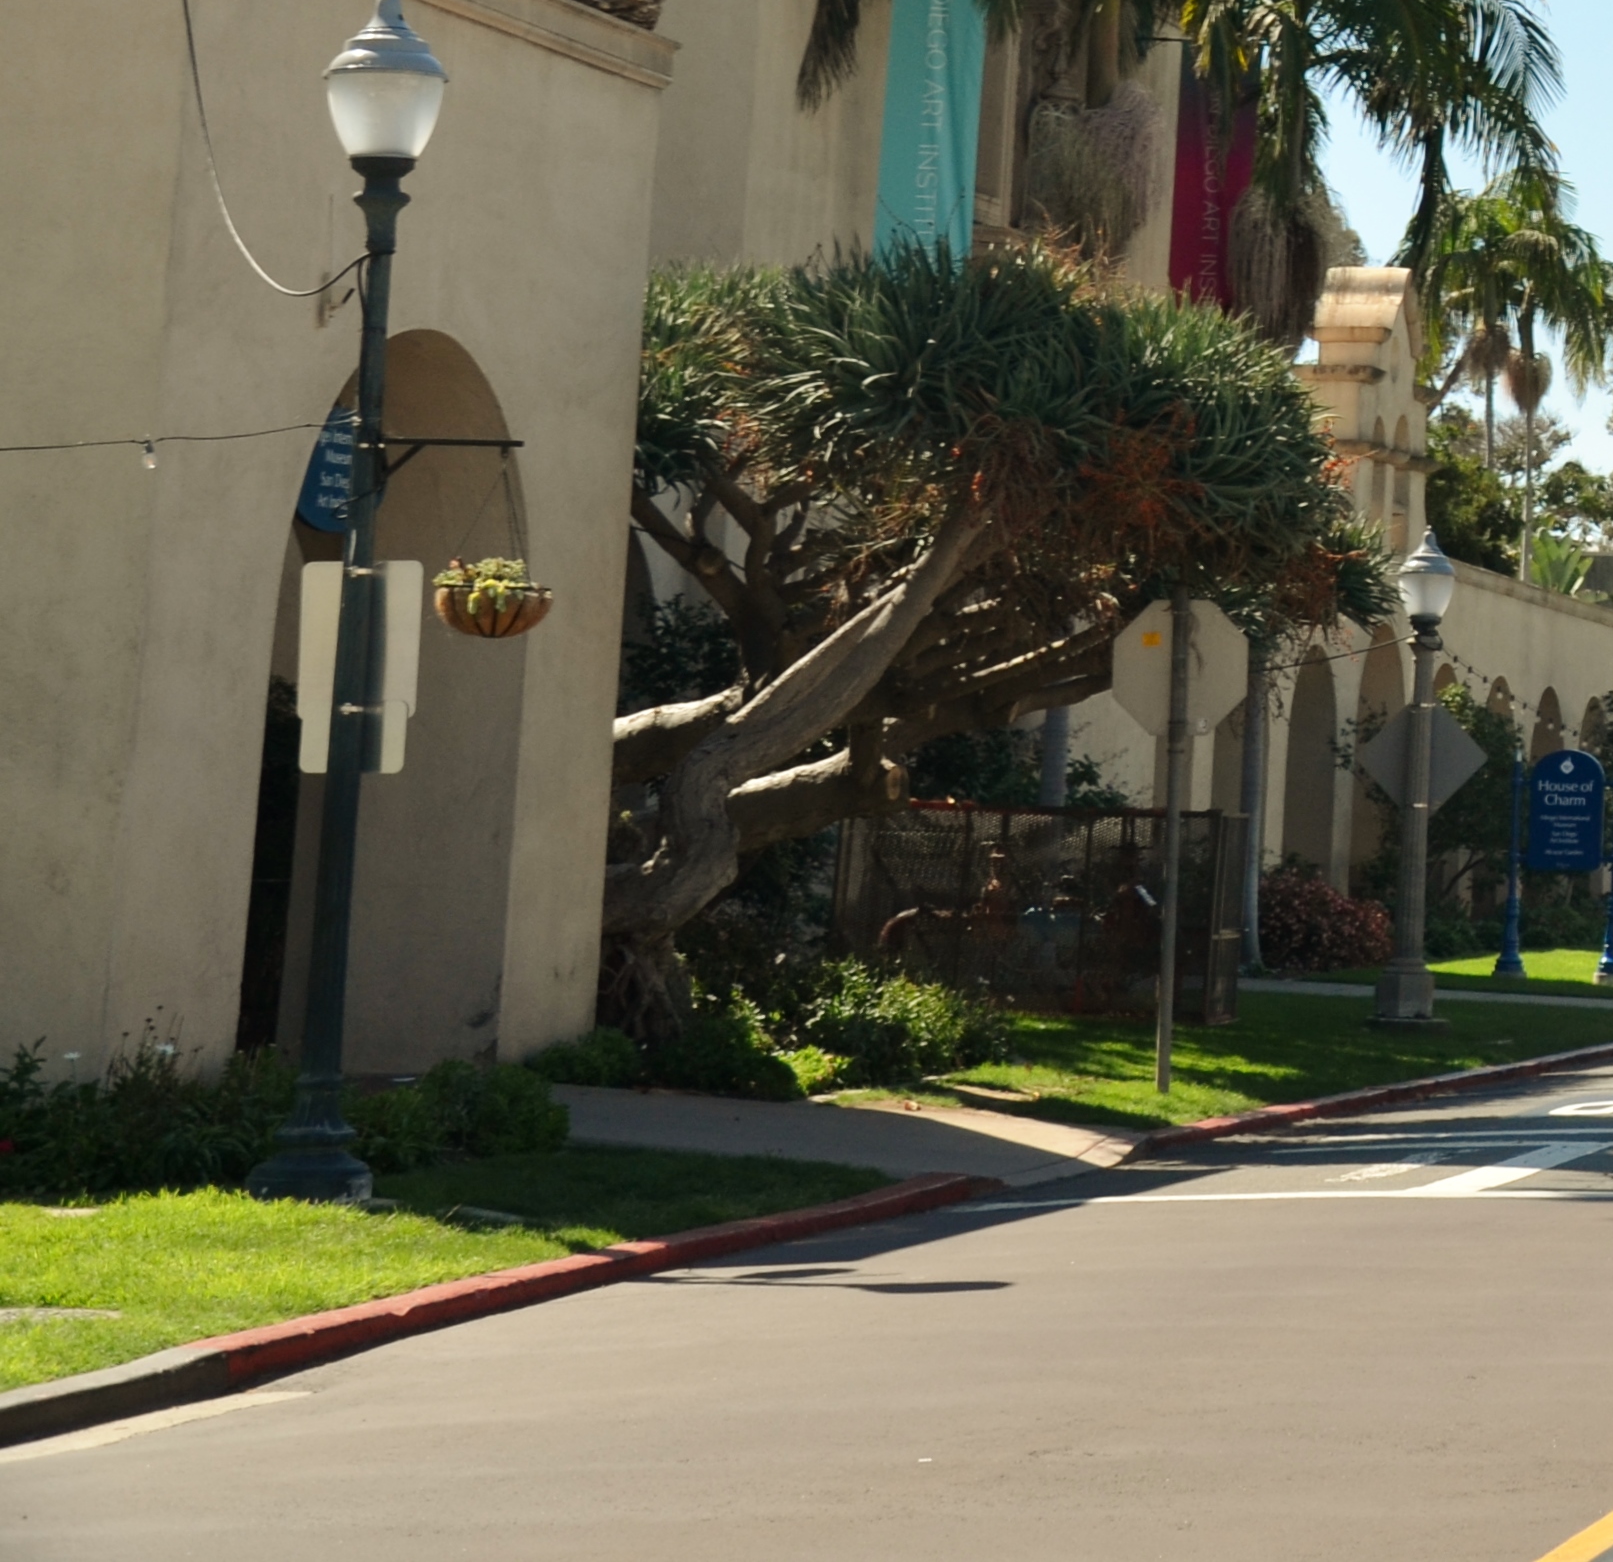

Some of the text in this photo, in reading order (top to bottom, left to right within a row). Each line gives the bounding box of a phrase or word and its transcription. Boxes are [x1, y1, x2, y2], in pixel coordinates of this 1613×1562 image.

[922, 79, 944, 131] ART
[1201, 201, 1221, 244] ART
[1538, 779, 1594, 792] House of
[1544, 793, 1586, 806] Charm
